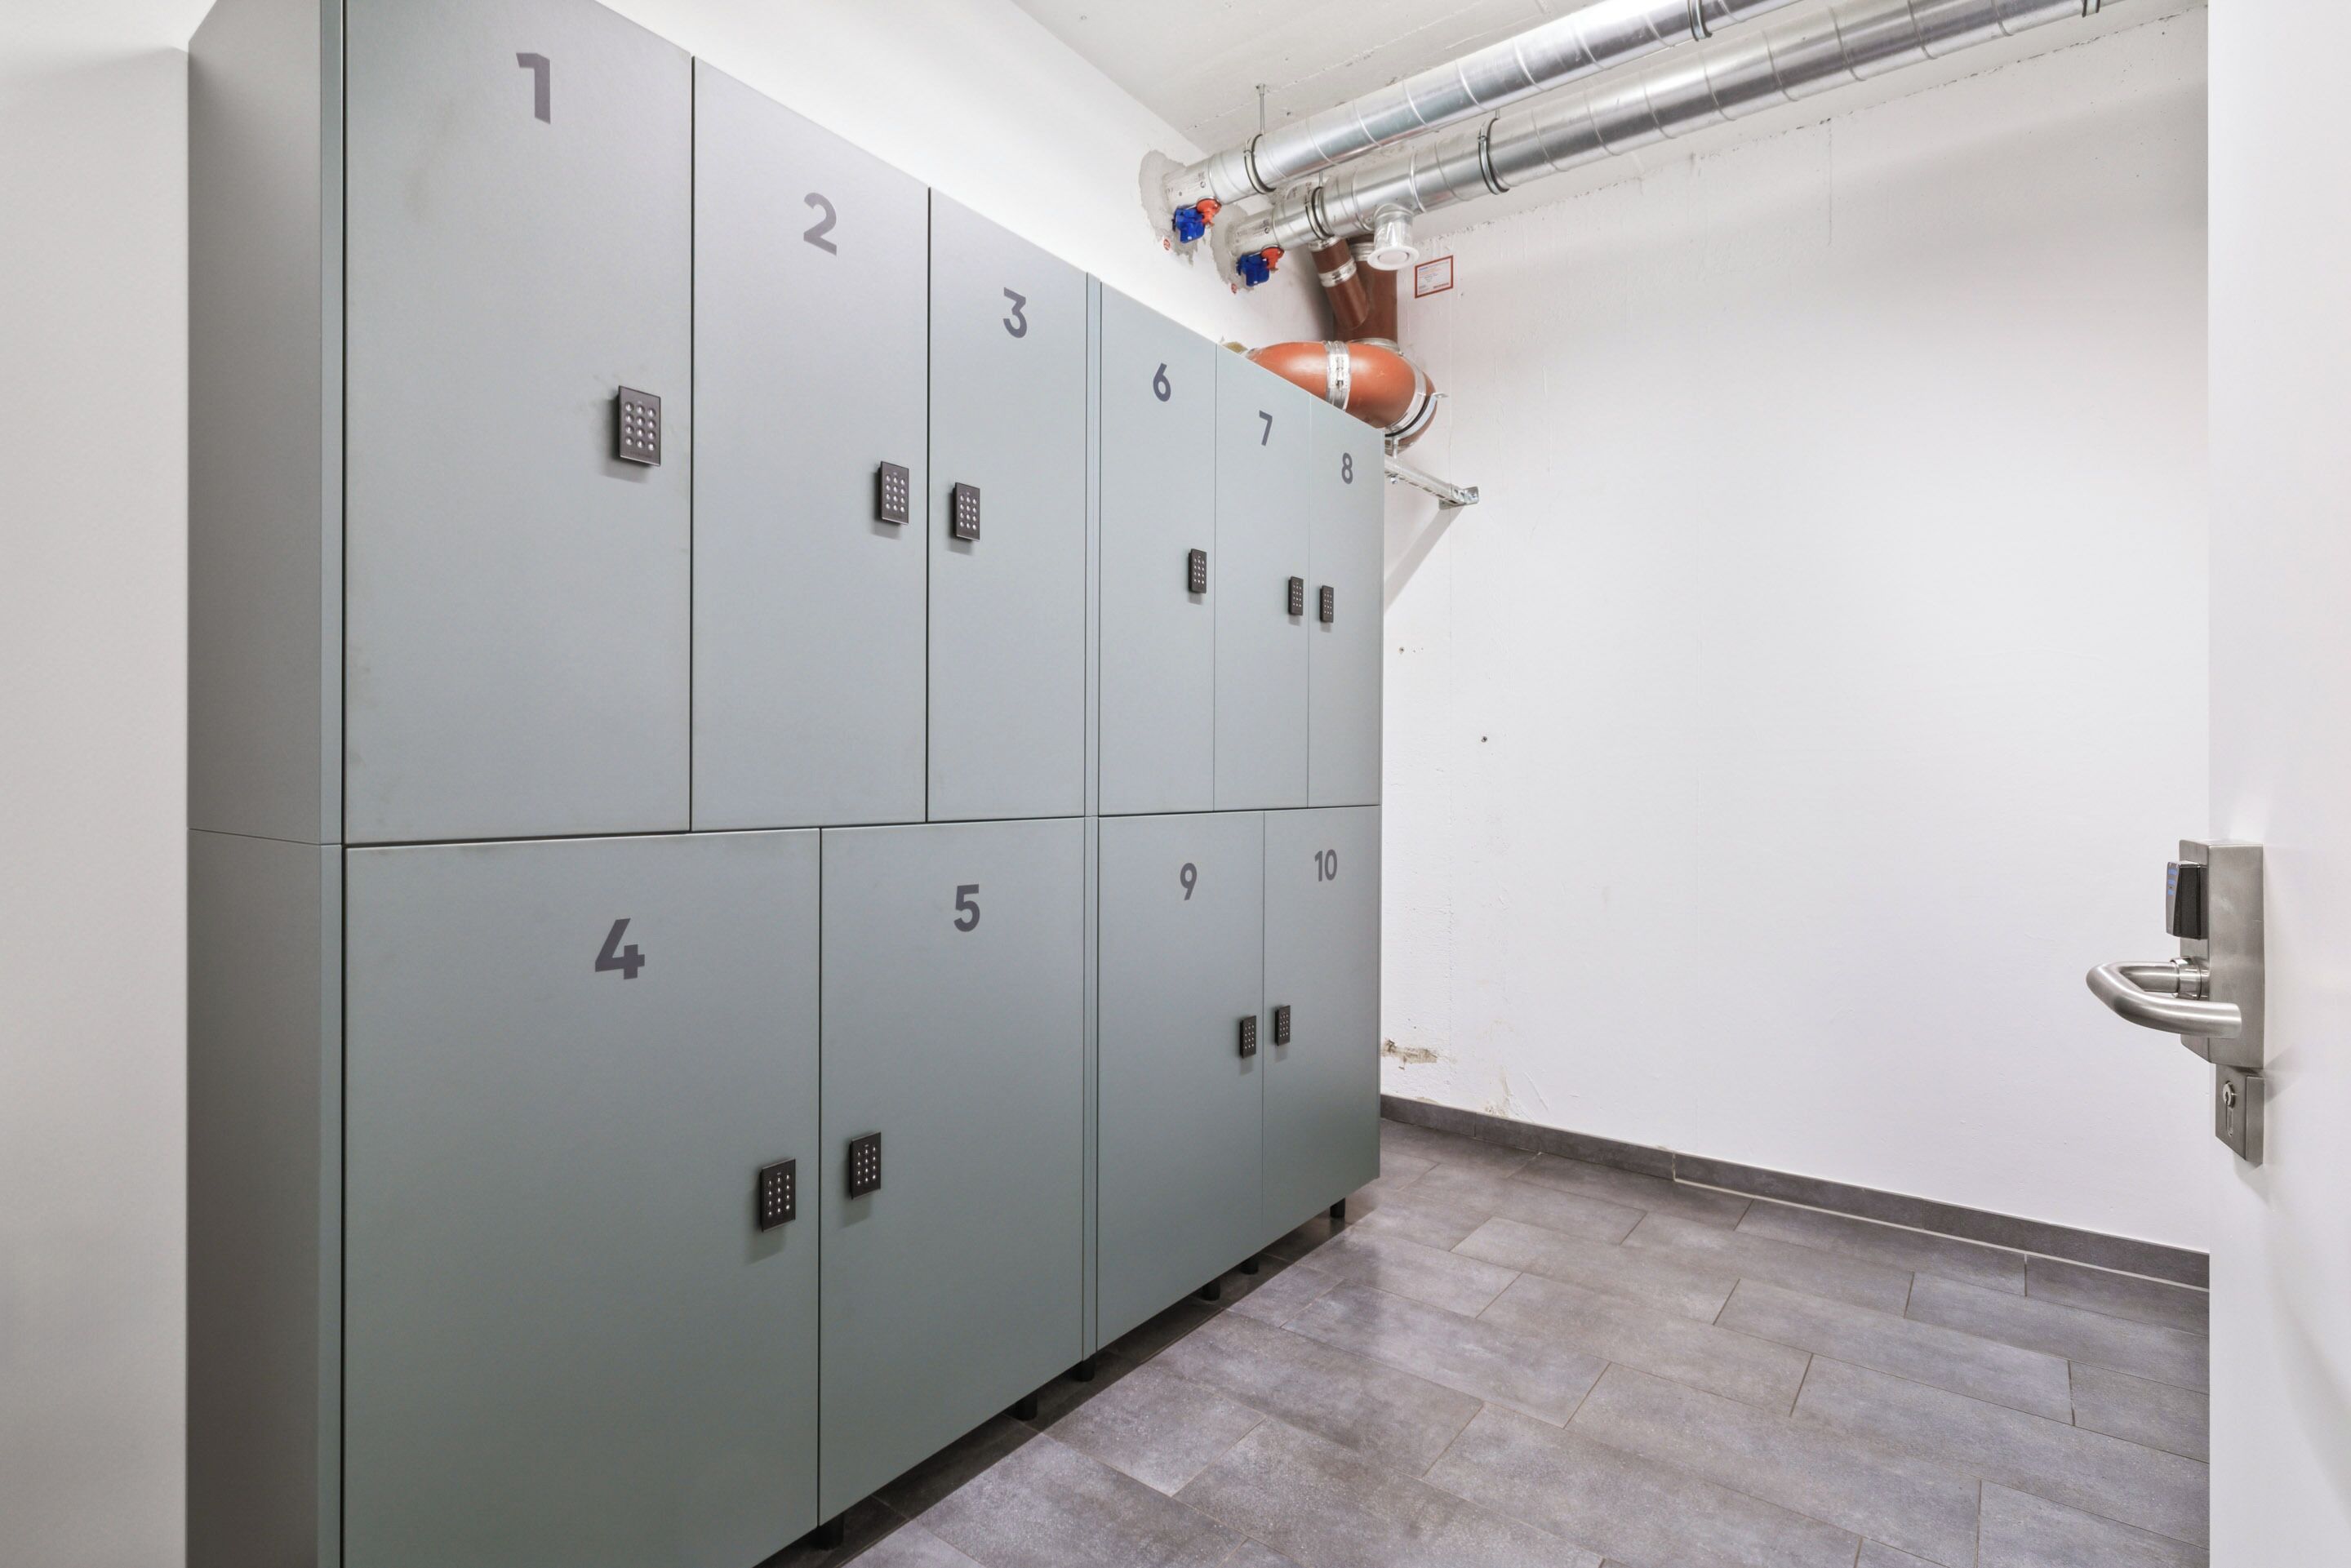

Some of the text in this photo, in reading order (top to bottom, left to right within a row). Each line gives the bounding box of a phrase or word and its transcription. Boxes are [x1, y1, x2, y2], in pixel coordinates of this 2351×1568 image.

[515, 52, 551, 125] 1
[803, 193, 838, 256] 2
[1002, 287, 1028, 339] 3
[1153, 362, 1171, 402] 6
[1259, 410, 1273, 446] 7
[1341, 452, 1353, 485] 8
[1180, 862, 1198, 901] 9
[1314, 849, 1338, 882] 10
[953, 884, 980, 932] 5
[594, 917, 646, 980] 4
